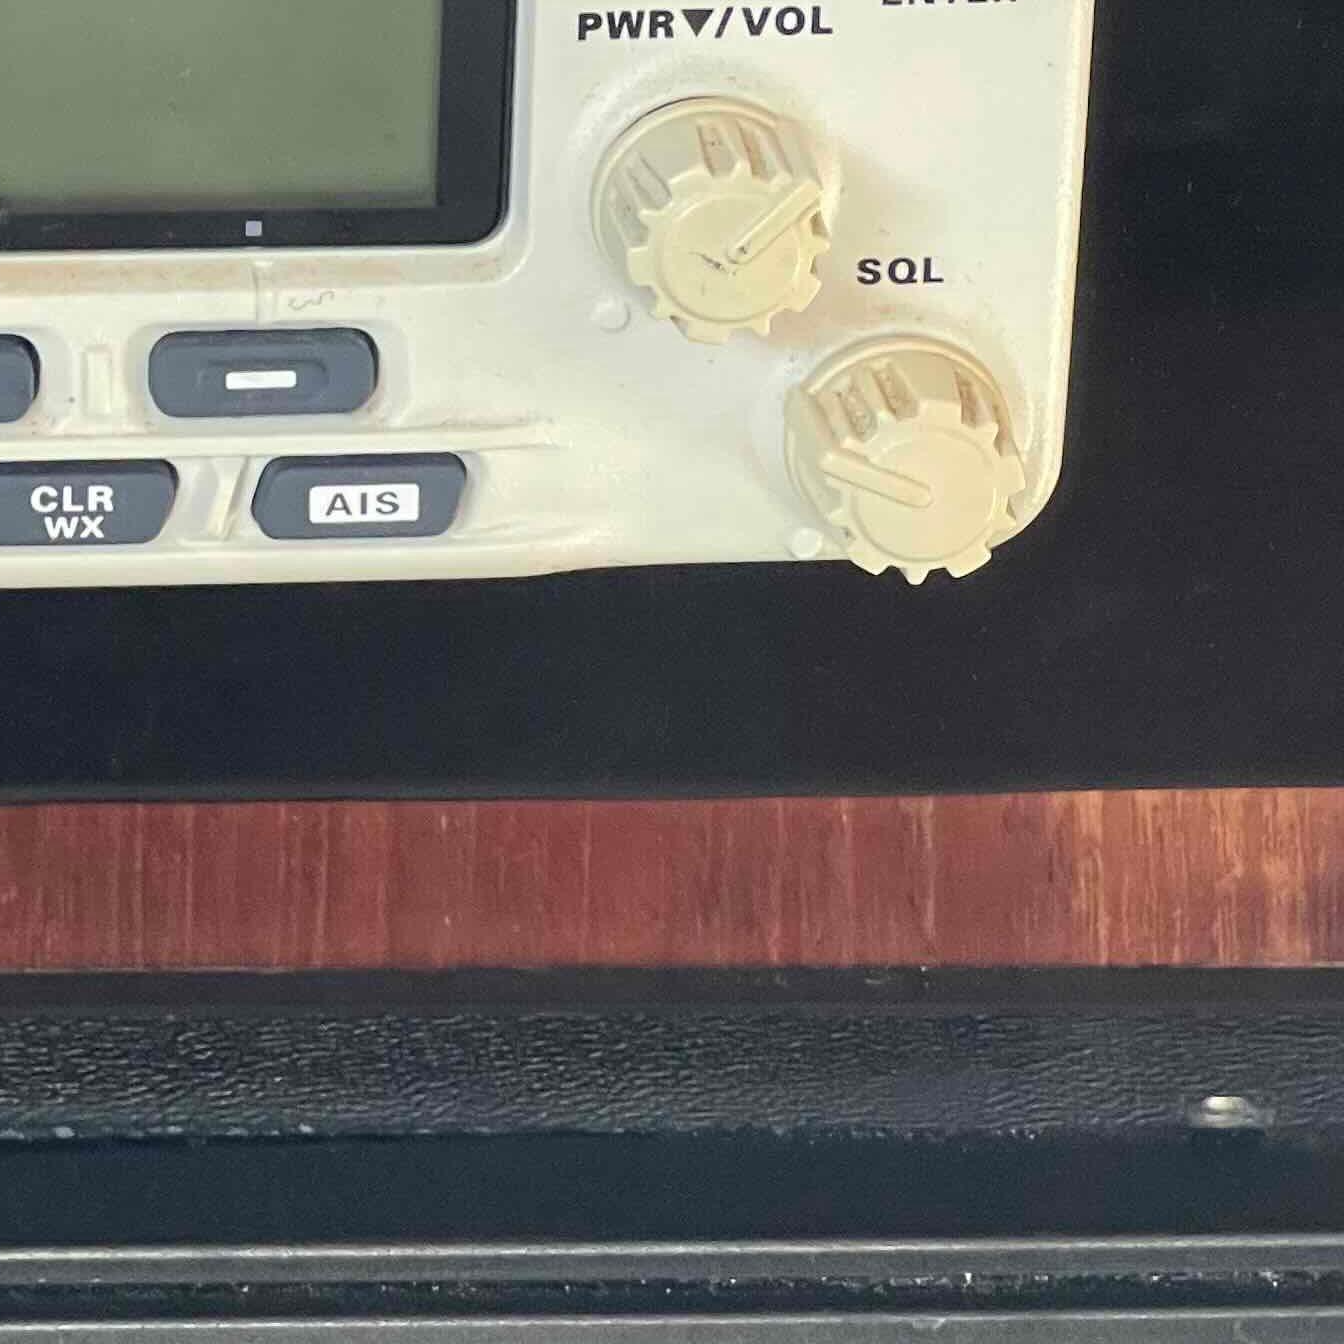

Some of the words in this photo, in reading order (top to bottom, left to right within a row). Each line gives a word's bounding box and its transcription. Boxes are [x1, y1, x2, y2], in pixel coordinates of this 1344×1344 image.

[856, 257, 945, 286] SQL
[30, 485, 114, 513] CLR
[326, 491, 399, 518] AIS
[44, 517, 105, 540] WX
